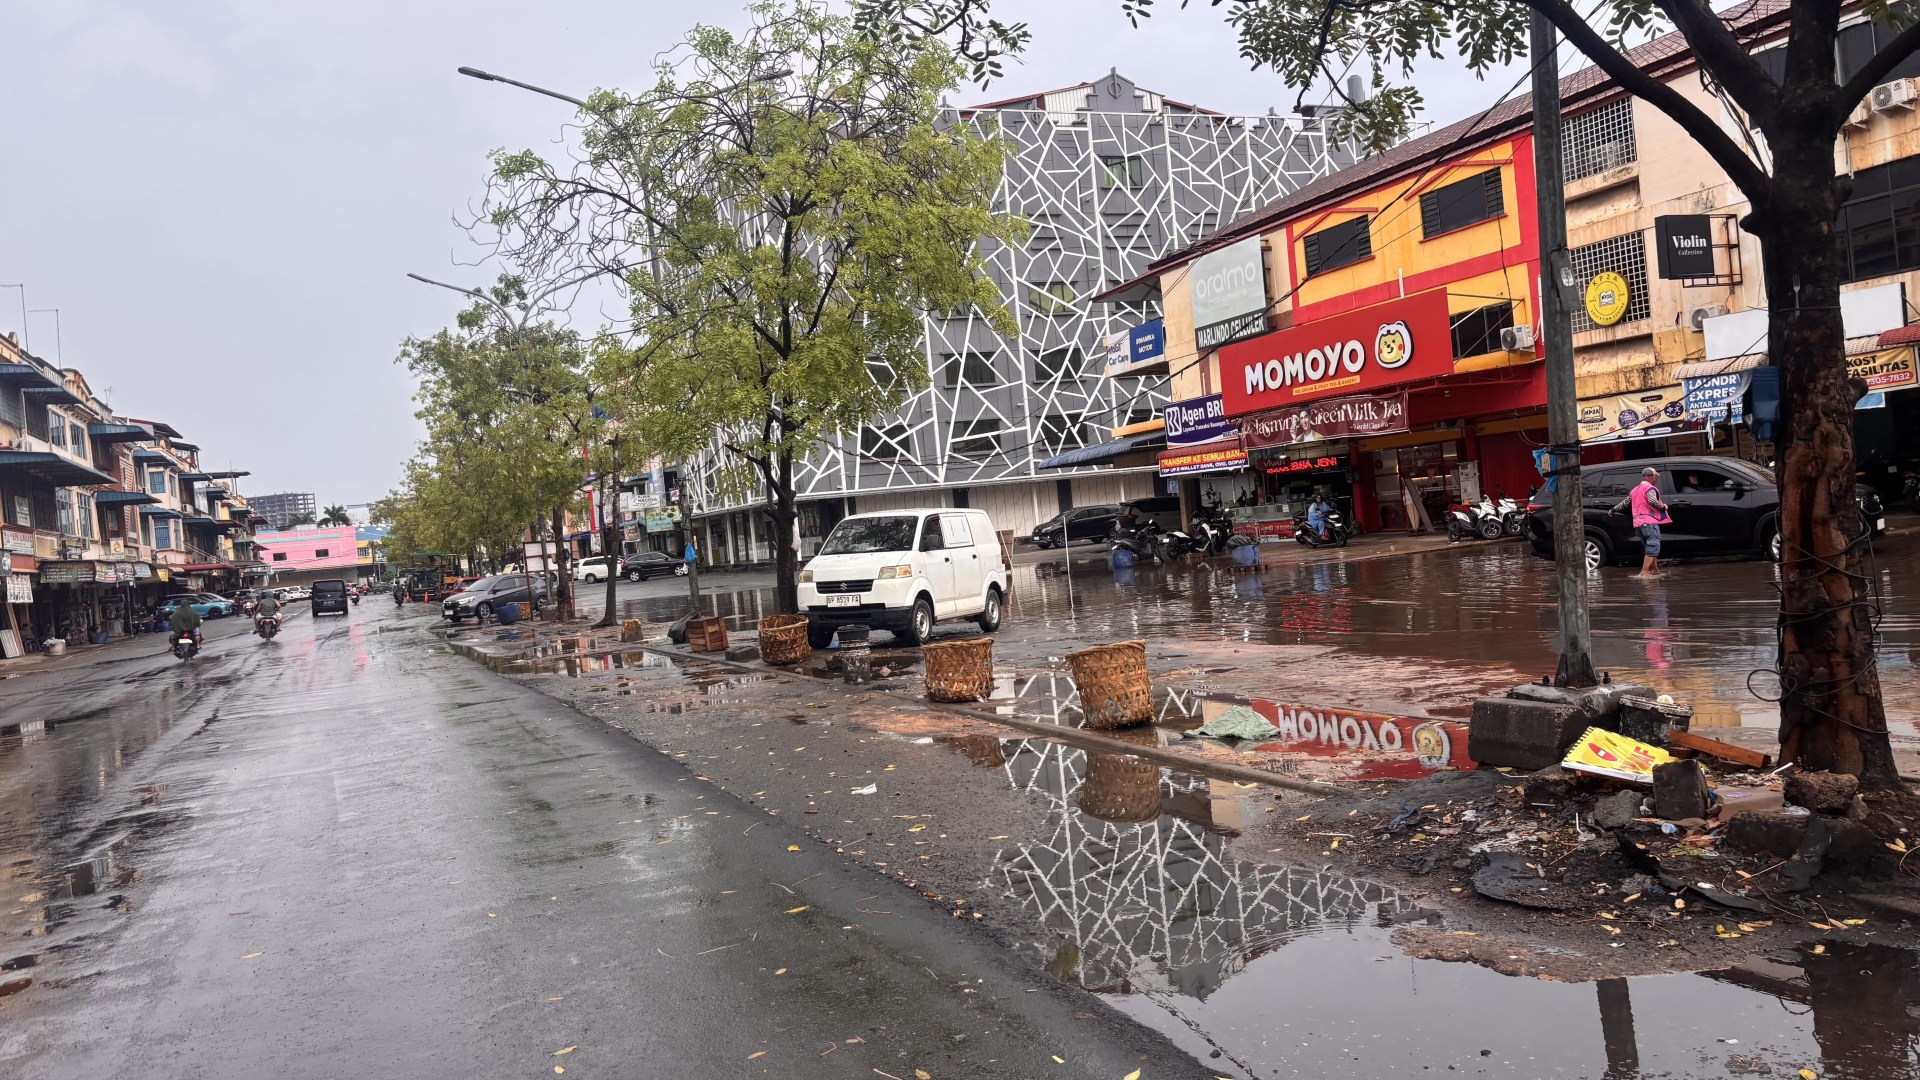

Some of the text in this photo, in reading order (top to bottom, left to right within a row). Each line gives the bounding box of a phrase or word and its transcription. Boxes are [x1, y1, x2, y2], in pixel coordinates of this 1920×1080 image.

[1672, 235, 1707, 248] Violin
[1196, 262, 1256, 298] oraimo
[1592, 274, 1618, 287] KP2A
[1197, 323, 1230, 348] MARLINDO
[1138, 344, 1153, 353] MOTOR
[1109, 355, 1129, 366] Car Care
[1244, 339, 1365, 395] MOMOYO
[1846, 355, 1877, 368] KOST
[1847, 360, 1909, 378] FASILITAS
[1584, 408, 1600, 416] KP2A
[1689, 401, 1713, 409] ANTAR
[1181, 406, 1205, 426] Agen
[1310, 404, 1346, 426] Green
[1347, 401, 1379, 421] Milk
[1380, 400, 1402, 419] Tea
[1162, 456, 1192, 467] TRANSFER
[1193, 455, 1202, 463] KE
[1203, 452, 1225, 461] SEMUA
